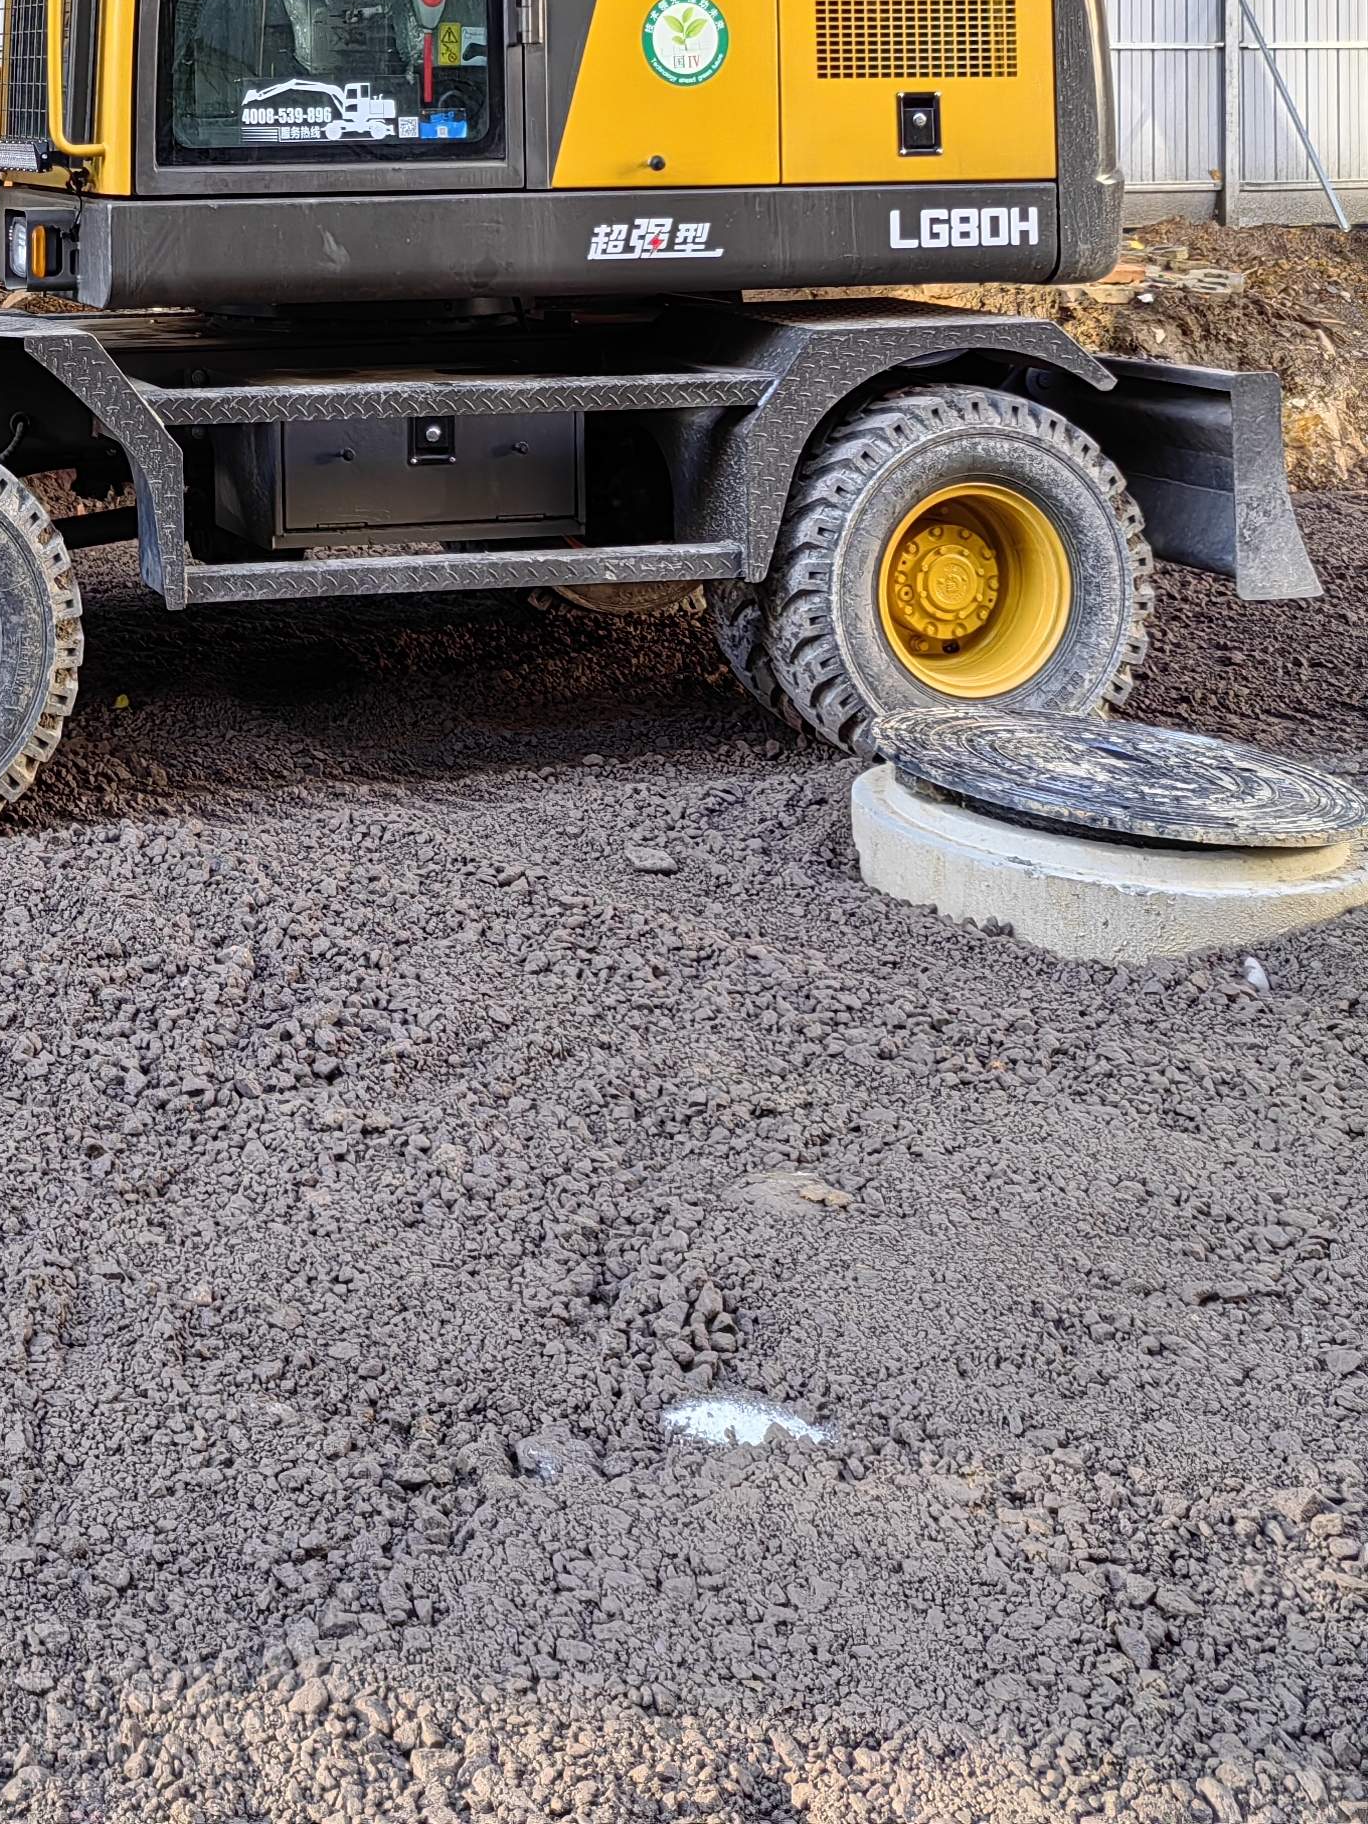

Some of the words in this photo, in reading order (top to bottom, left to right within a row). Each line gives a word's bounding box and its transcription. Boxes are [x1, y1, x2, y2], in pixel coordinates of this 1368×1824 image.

[241, 106, 332, 125] 4008-539-896
[586, 217, 724, 261] 超强型
[889, 206, 1038, 250] LG80H
